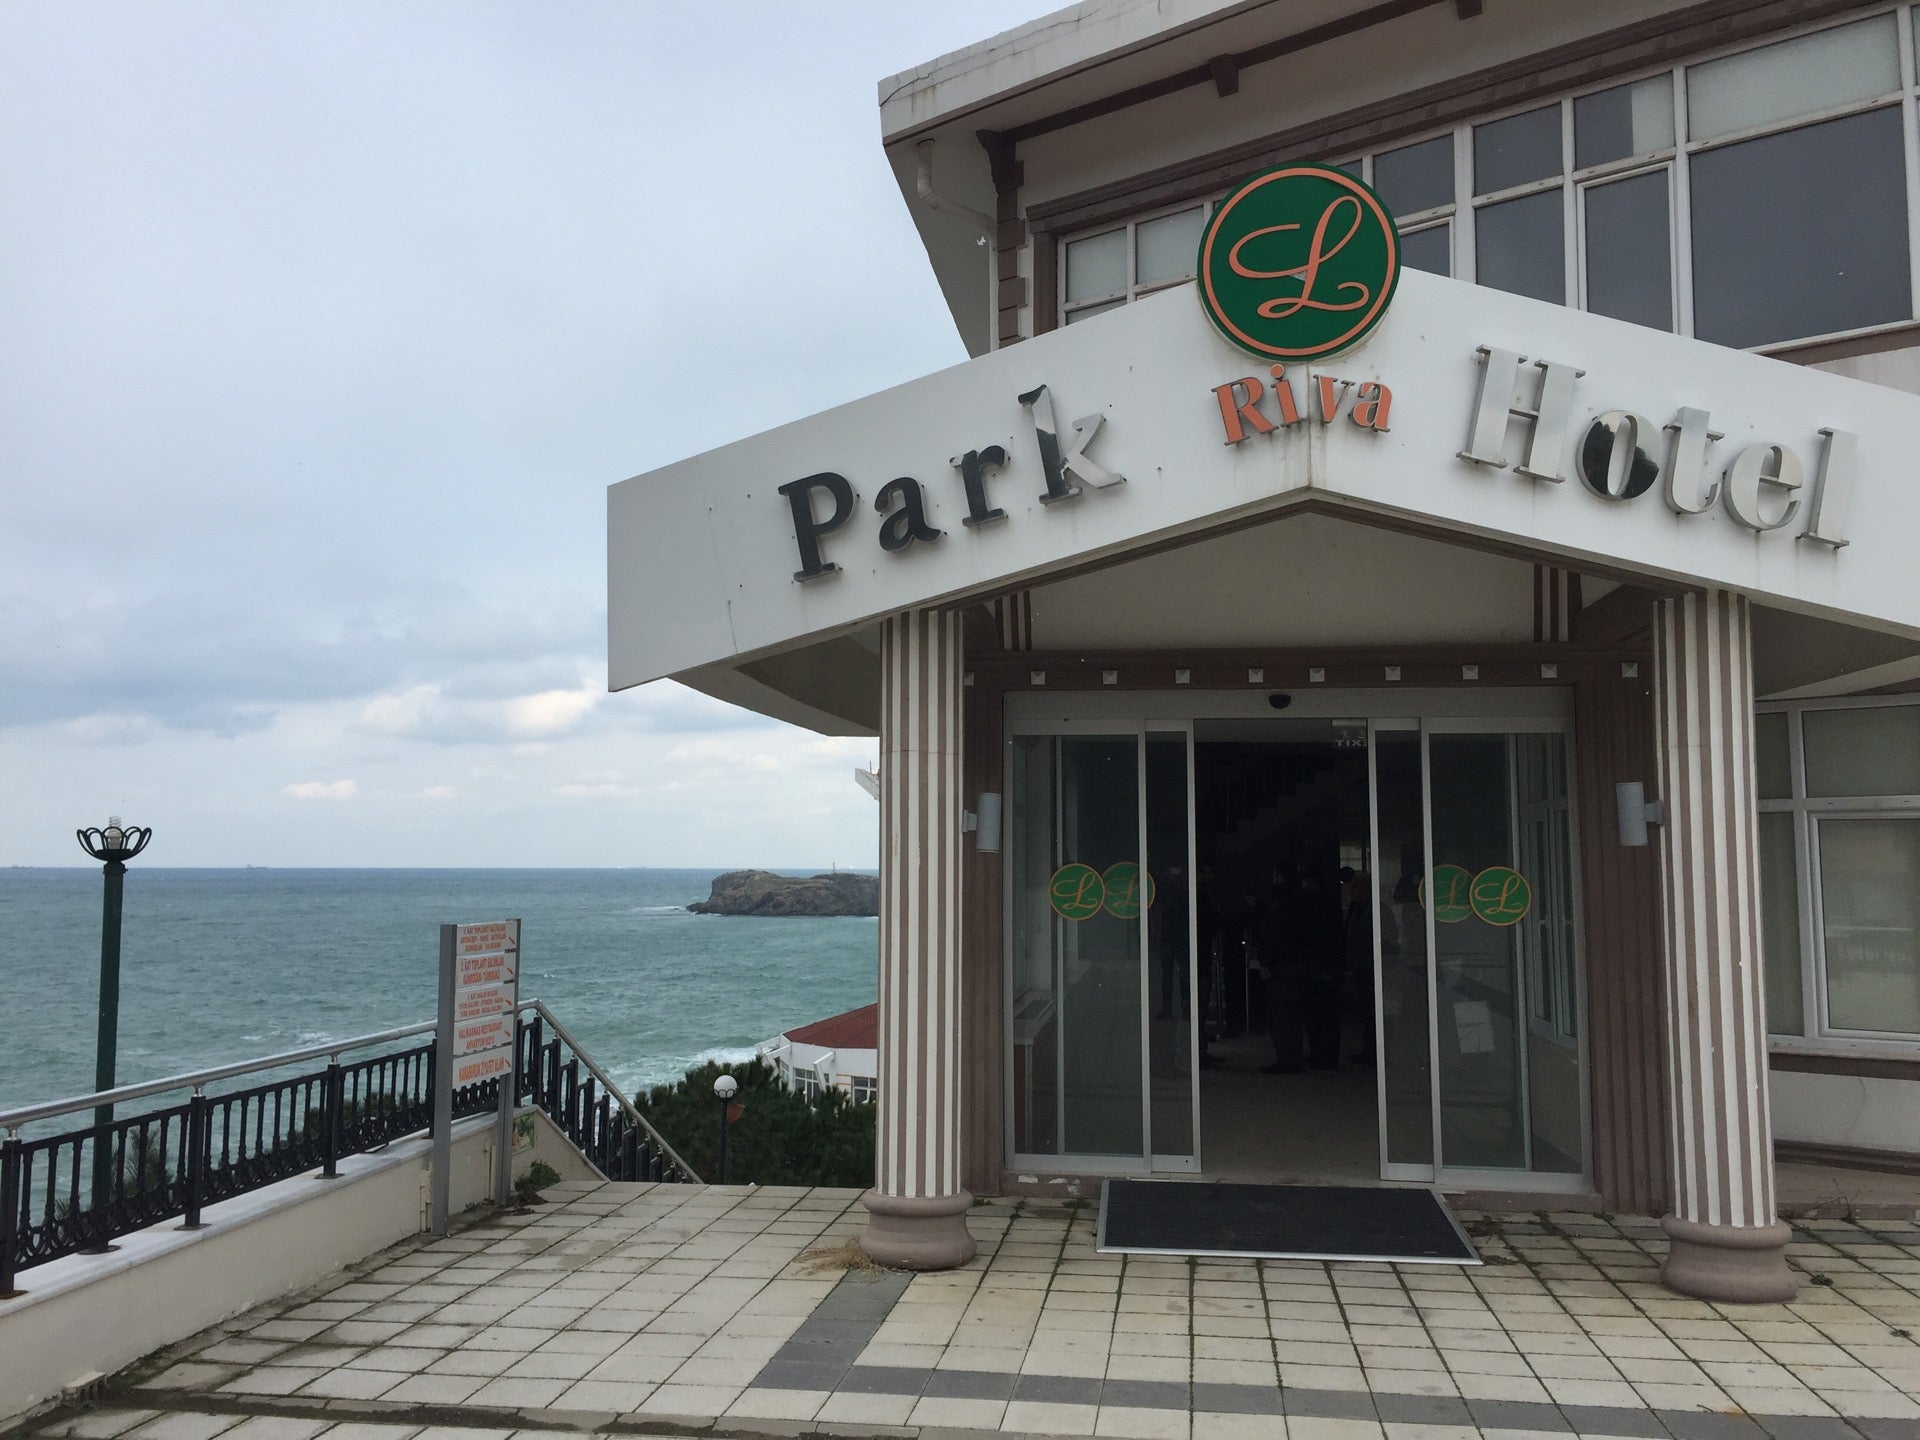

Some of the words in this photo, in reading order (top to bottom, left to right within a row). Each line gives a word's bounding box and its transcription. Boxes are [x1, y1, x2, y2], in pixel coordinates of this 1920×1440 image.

[778, 384, 1127, 582] Park
[1211, 363, 1393, 446] Riva
[1455, 343, 1858, 550] Hotel
